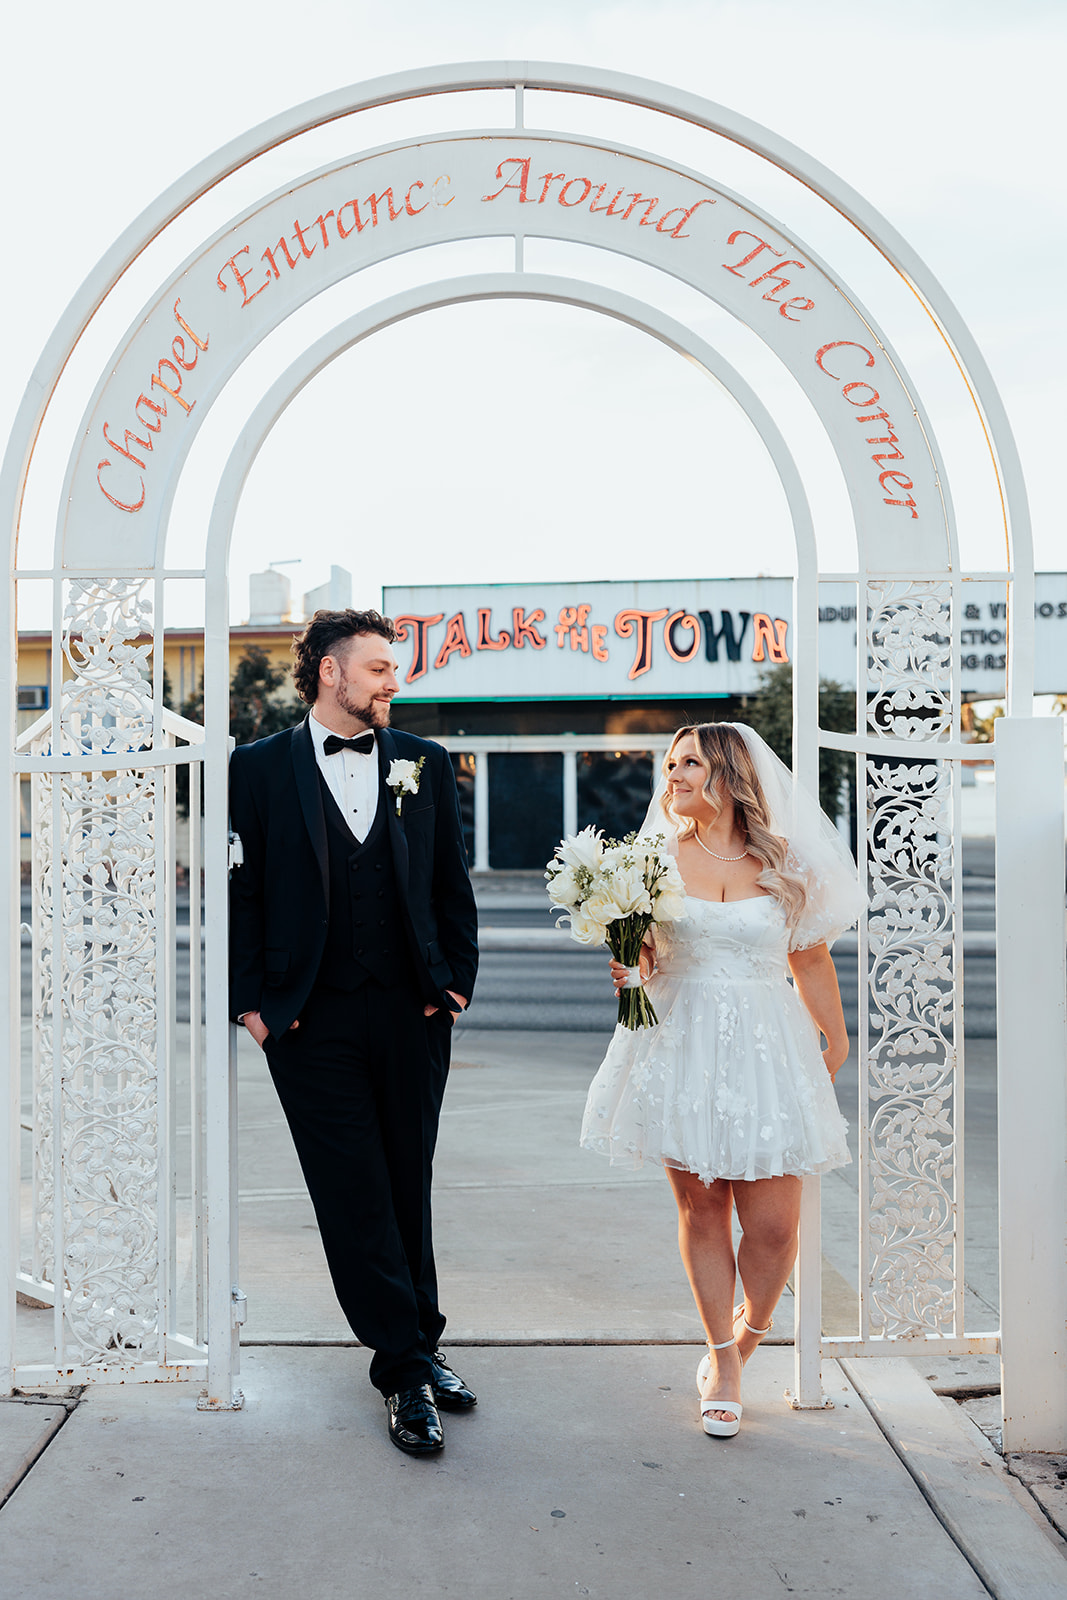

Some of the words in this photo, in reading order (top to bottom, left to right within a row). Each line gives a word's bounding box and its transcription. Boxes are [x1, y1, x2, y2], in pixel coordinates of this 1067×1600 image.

[97, 297, 210, 514] Chapel
[215, 174, 456, 309] Entrance
[482, 156, 717, 239] Around
[721, 229, 816, 323] The
[814, 339, 919, 520] Corner
[558, 603, 592, 628] OF
[964, 604, 980, 620] &
[395, 607, 547, 685] TALK
[553, 624, 609, 663] THE
[613, 607, 790, 681] TOWN
